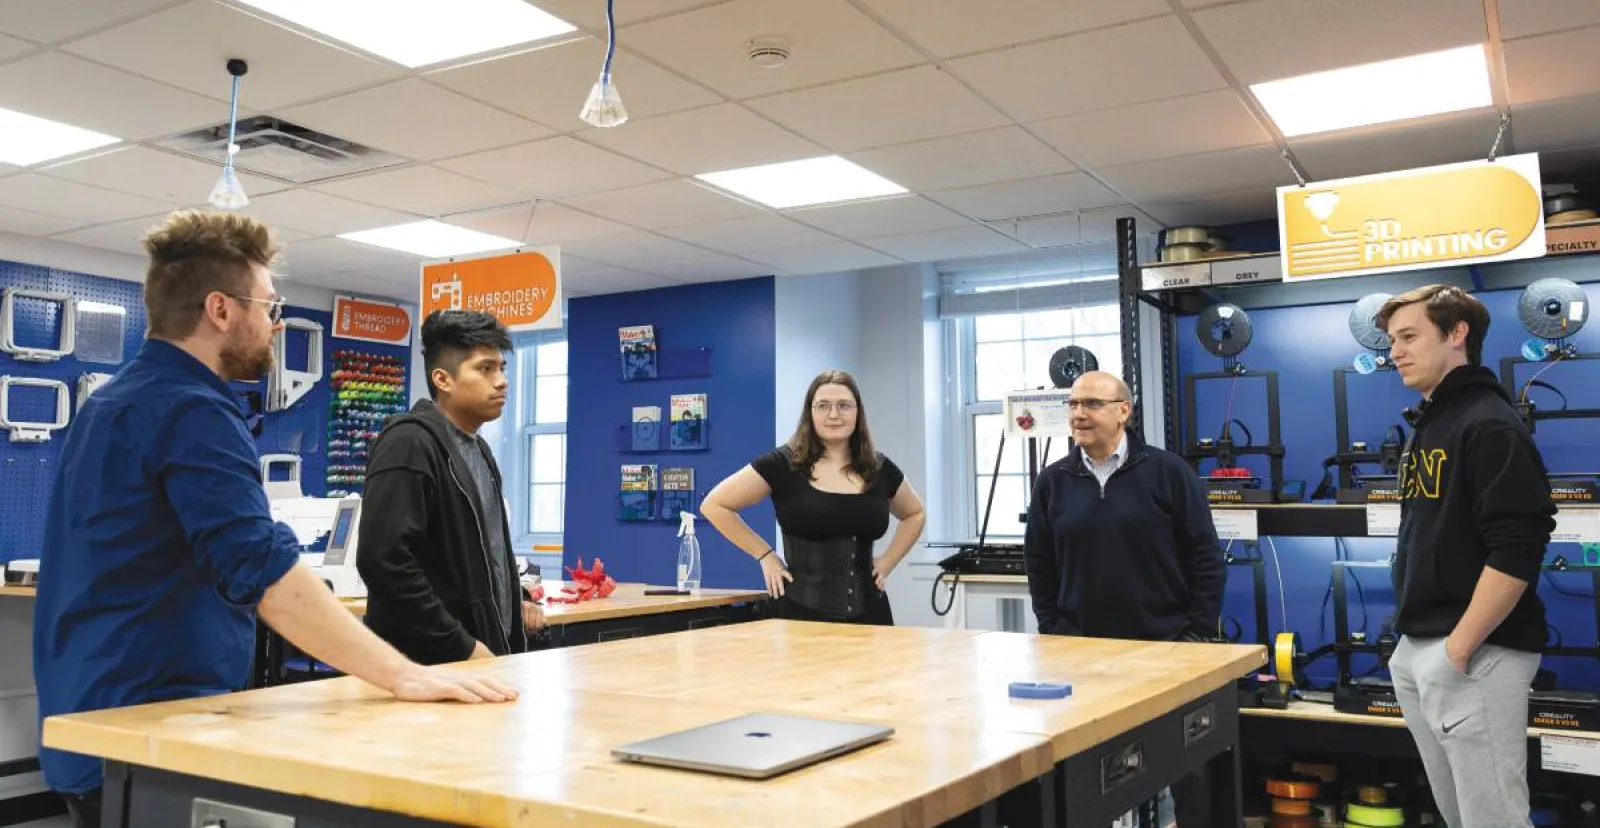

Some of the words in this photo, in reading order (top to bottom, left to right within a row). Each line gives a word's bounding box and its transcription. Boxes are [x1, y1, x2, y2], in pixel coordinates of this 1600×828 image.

[1364, 218, 1401, 241] 3D
[1365, 227, 1509, 263] PRINTING
[1163, 278, 1190, 287] CLEAR
[1235, 271, 1260, 280] GREY
[467, 286, 548, 308] EMBROIDERY
[354, 311, 406, 326] EMBROIDERY
[354, 321, 386, 333] THREAD
